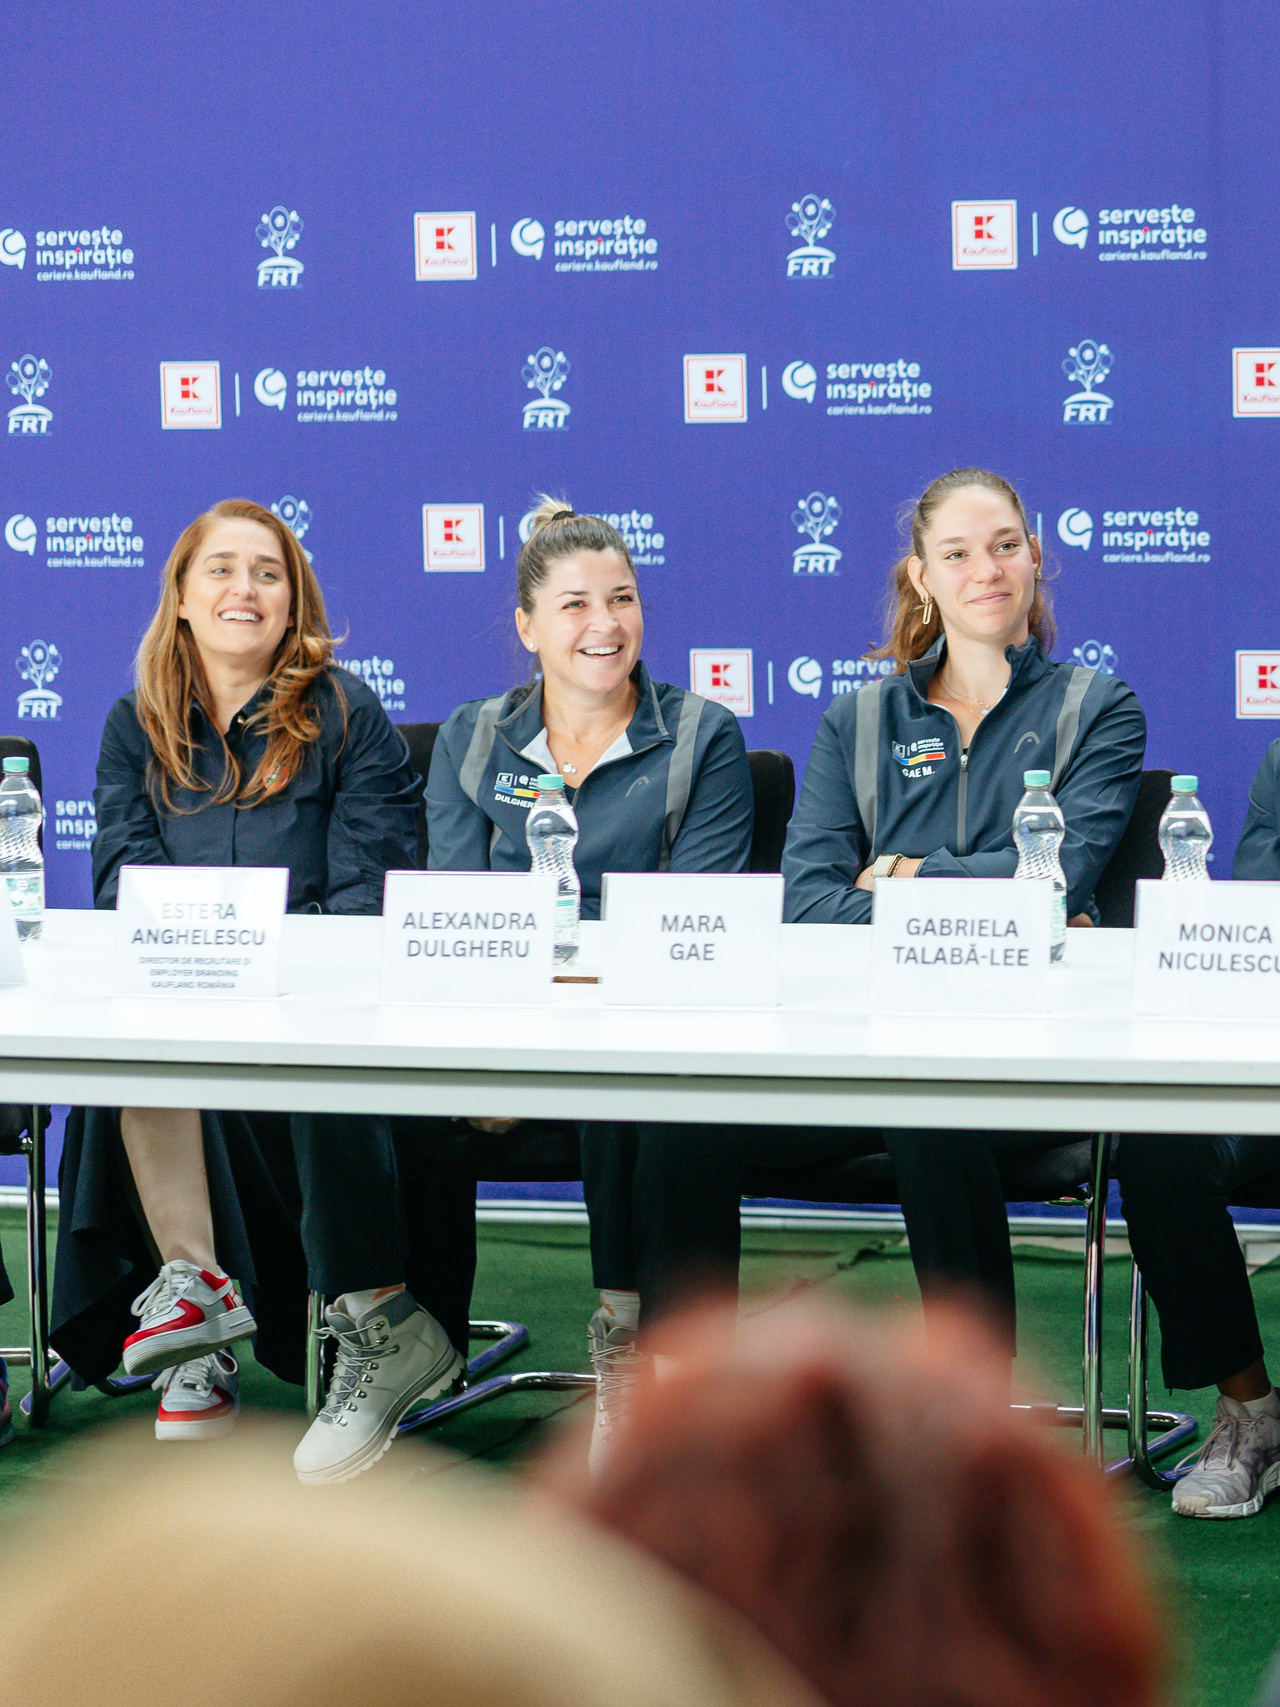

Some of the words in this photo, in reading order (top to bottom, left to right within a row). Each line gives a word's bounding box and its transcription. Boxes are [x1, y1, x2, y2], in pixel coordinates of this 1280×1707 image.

[973, 215, 995, 240] K
[435, 227, 455, 251] K
[1099, 247, 1207, 261] cariere.kaufland.ro
[786, 258, 836, 276] FRT
[257, 269, 304, 286] FRT
[704, 369, 725, 393] K
[1254, 362, 1276, 387] K
[180, 376, 199, 400] K
[523, 411, 571, 428] FRT
[1063, 404, 1114, 422] FRT
[8, 417, 53, 433] FRT
[443, 519, 462, 542] K
[793, 556, 842, 573] FRT
[1103, 549, 1210, 563] cariere.kaufland.ro
[710, 663, 731, 687] K
[1257, 664, 1279, 690] K
[17, 702, 63, 718] FRT
[902, 767, 922, 778] GAE
[494, 793, 534, 809] DULGHER
[161, 902, 238, 920] ESTERA
[402, 911, 537, 931] ALEXANDRA
[660, 914, 727, 933] MARA
[906, 917, 1019, 938] GABRIELA
[131, 928, 266, 946] ANGHELESCU
[1178, 922, 1273, 945] MONICA
[406, 939, 530, 959] DULGHERU
[669, 942, 715, 962] GAE
[893, 944, 1030, 968] TALABĂ-LEE
[149, 968, 194, 977] EMPLOYER
[150, 981, 195, 989] KAUFLAND
